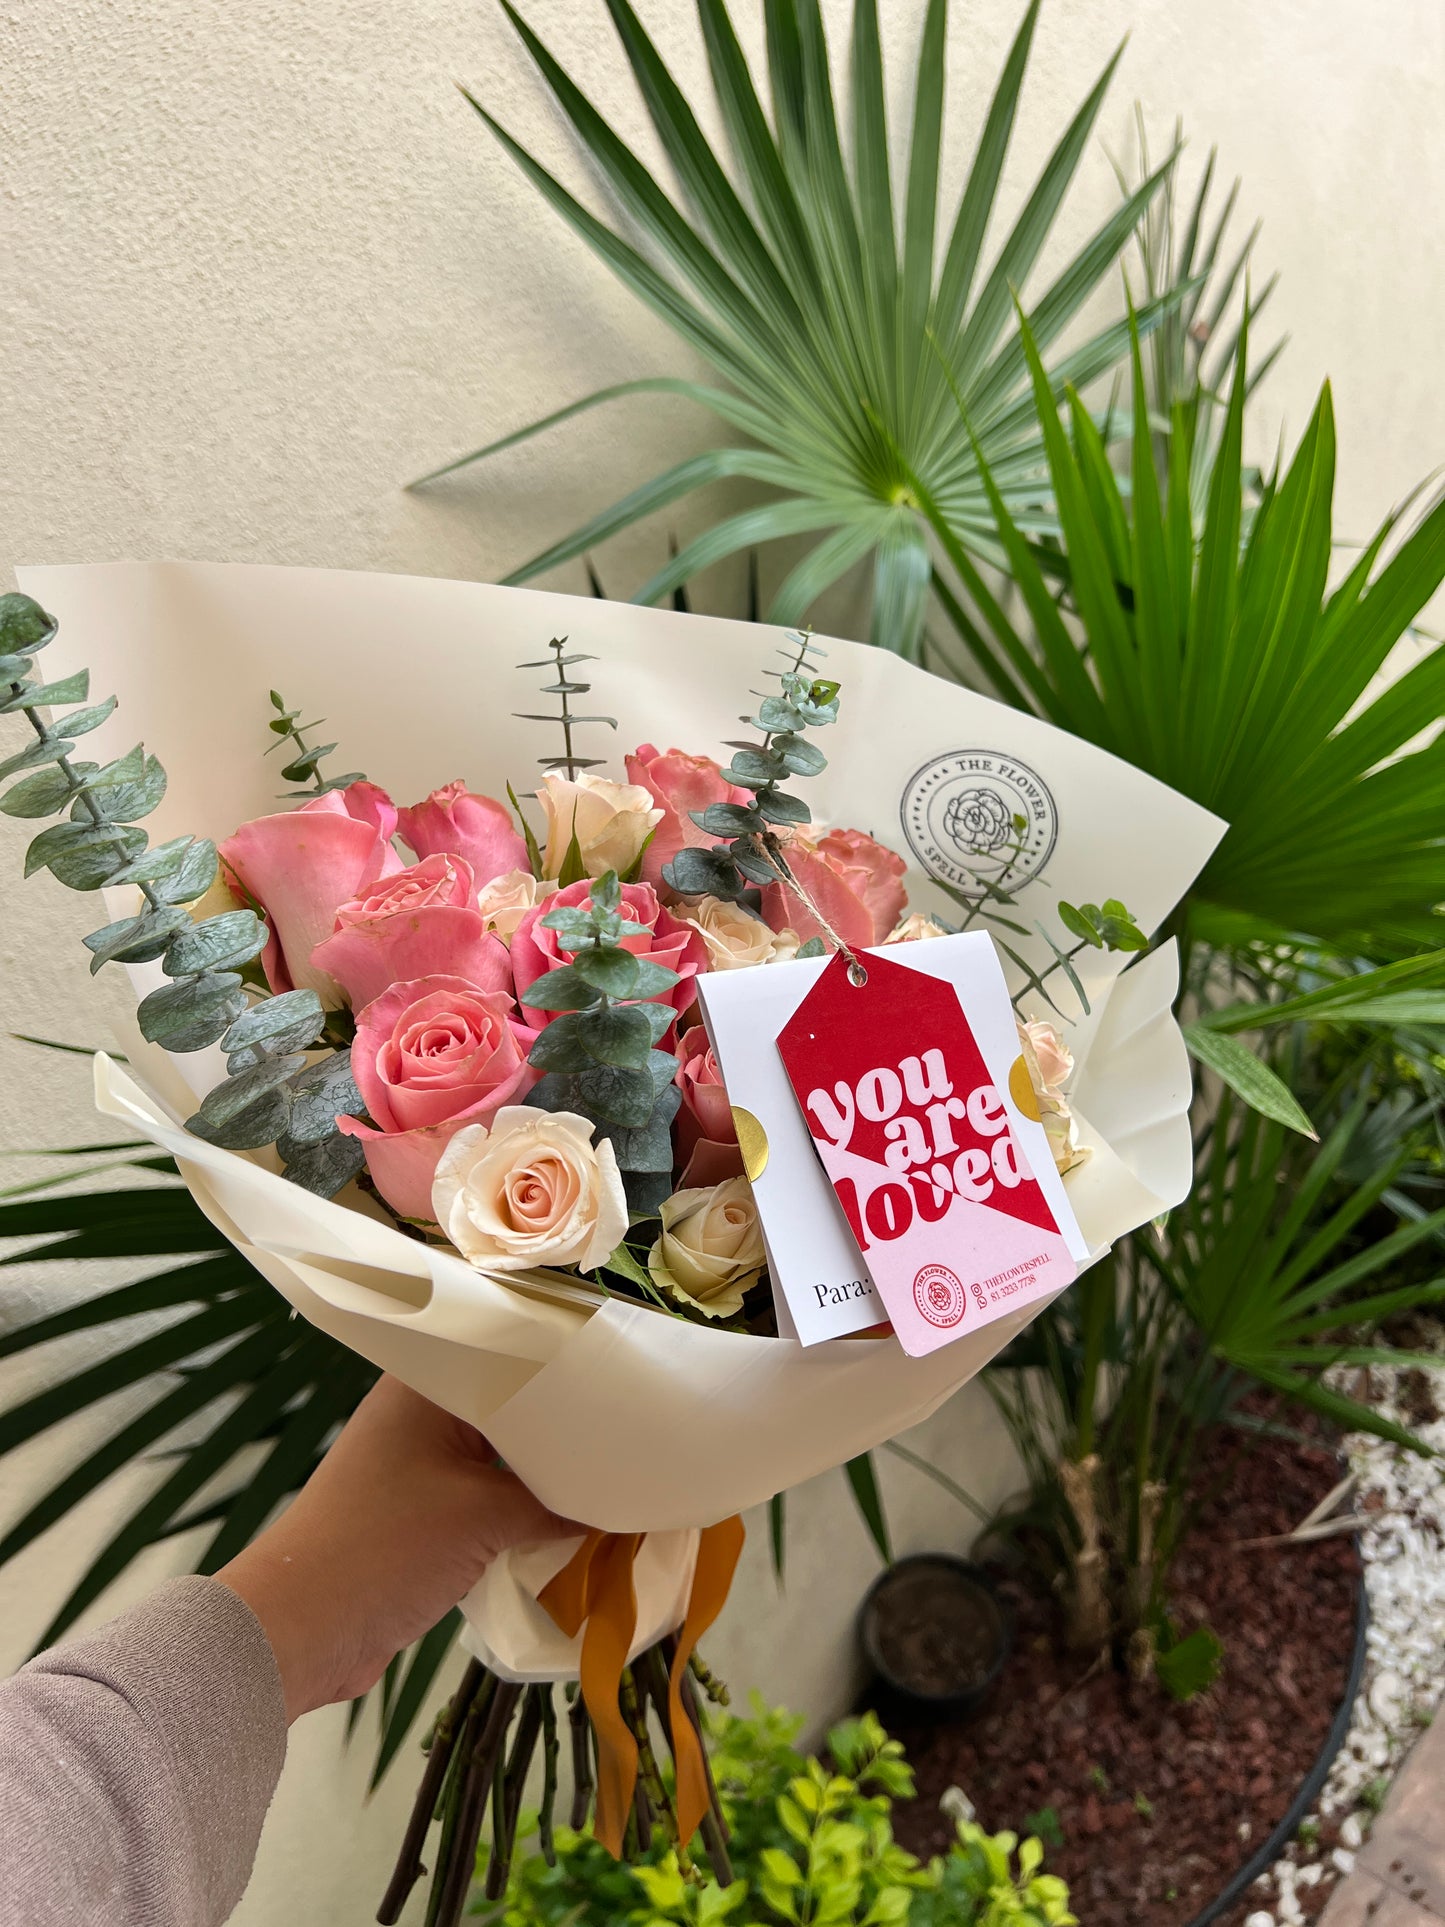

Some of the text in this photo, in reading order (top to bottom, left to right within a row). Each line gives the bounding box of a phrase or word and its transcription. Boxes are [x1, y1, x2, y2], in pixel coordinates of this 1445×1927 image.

[956, 759, 1047, 821] THE FLOWER
[924, 846, 967, 886] SPELL
[807, 1048, 954, 1151] you
[884, 1085, 1008, 1172] are
[833, 1116, 1037, 1252] loved
[917, 1268, 947, 1287] THE FLOWER
[983, 1253, 1052, 1289] THEFLOWERSPELL
[990, 1274, 1037, 1302] 81 3233 7738
[812, 1278, 872, 1309] Para:
